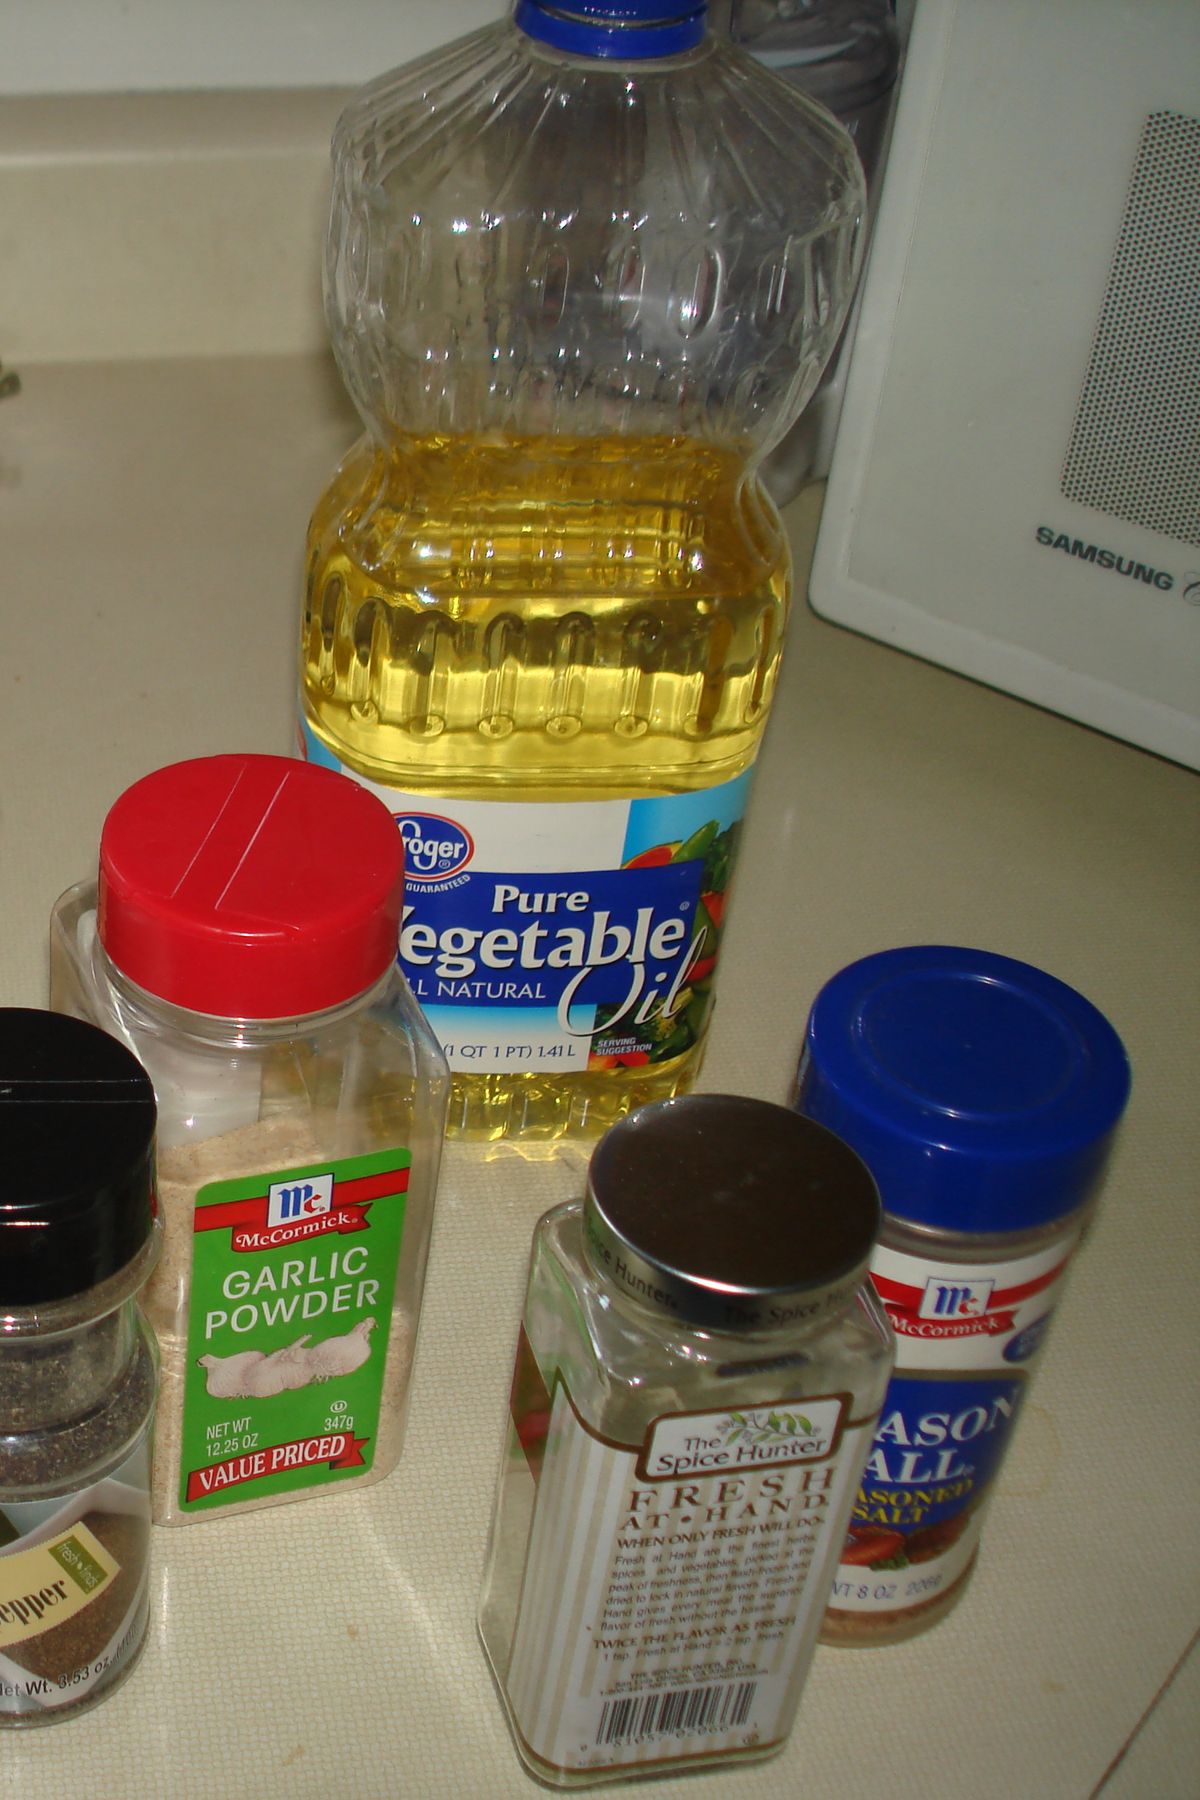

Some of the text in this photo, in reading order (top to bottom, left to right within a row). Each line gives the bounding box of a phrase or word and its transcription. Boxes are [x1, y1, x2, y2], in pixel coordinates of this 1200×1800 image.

[1035, 526, 1174, 591] SAMSUNG
[405, 874, 471, 894] GUARANTEED
[491, 884, 590, 914] Pure
[398, 905, 686, 979] egetable
[437, 981, 546, 1000] NATURAL
[556, 925, 709, 1037] Oil
[460, 1045, 488, 1060] QT
[504, 1044, 532, 1060] PT)
[567, 1045, 576, 1058] L
[597, 1037, 636, 1048] SERVING
[235, 1211, 350, 1248] McCormick
[222, 1246, 370, 1300] GARLIC
[204, 1279, 380, 1340] POWDER
[889, 1313, 1001, 1338] McCormick
[206, 1416, 252, 1440] NET WT
[323, 1414, 354, 1432] 347g
[874, 1396, 1014, 1446] ASON
[205, 1433, 259, 1458] 12.25 OZ
[656, 1436, 827, 1476] Spice Hunter
[684, 1436, 722, 1451] The
[200, 1435, 346, 1491] VALUE PRICED
[625, 1467, 837, 1513] FRESH
[618, 1494, 830, 1531] AT HAND
[616, 1536, 666, 1549] WHEN
[667, 1532, 709, 1545] ONLY
[712, 1525, 756, 1540] FRESH
[857, 1585, 869, 1600] 8
[594, 1637, 638, 1650] TWICE
[25, 1679, 53, 1696] Wt.
[57, 1667, 90, 1690] 3.53
[94, 1655, 114, 1674] oz.
